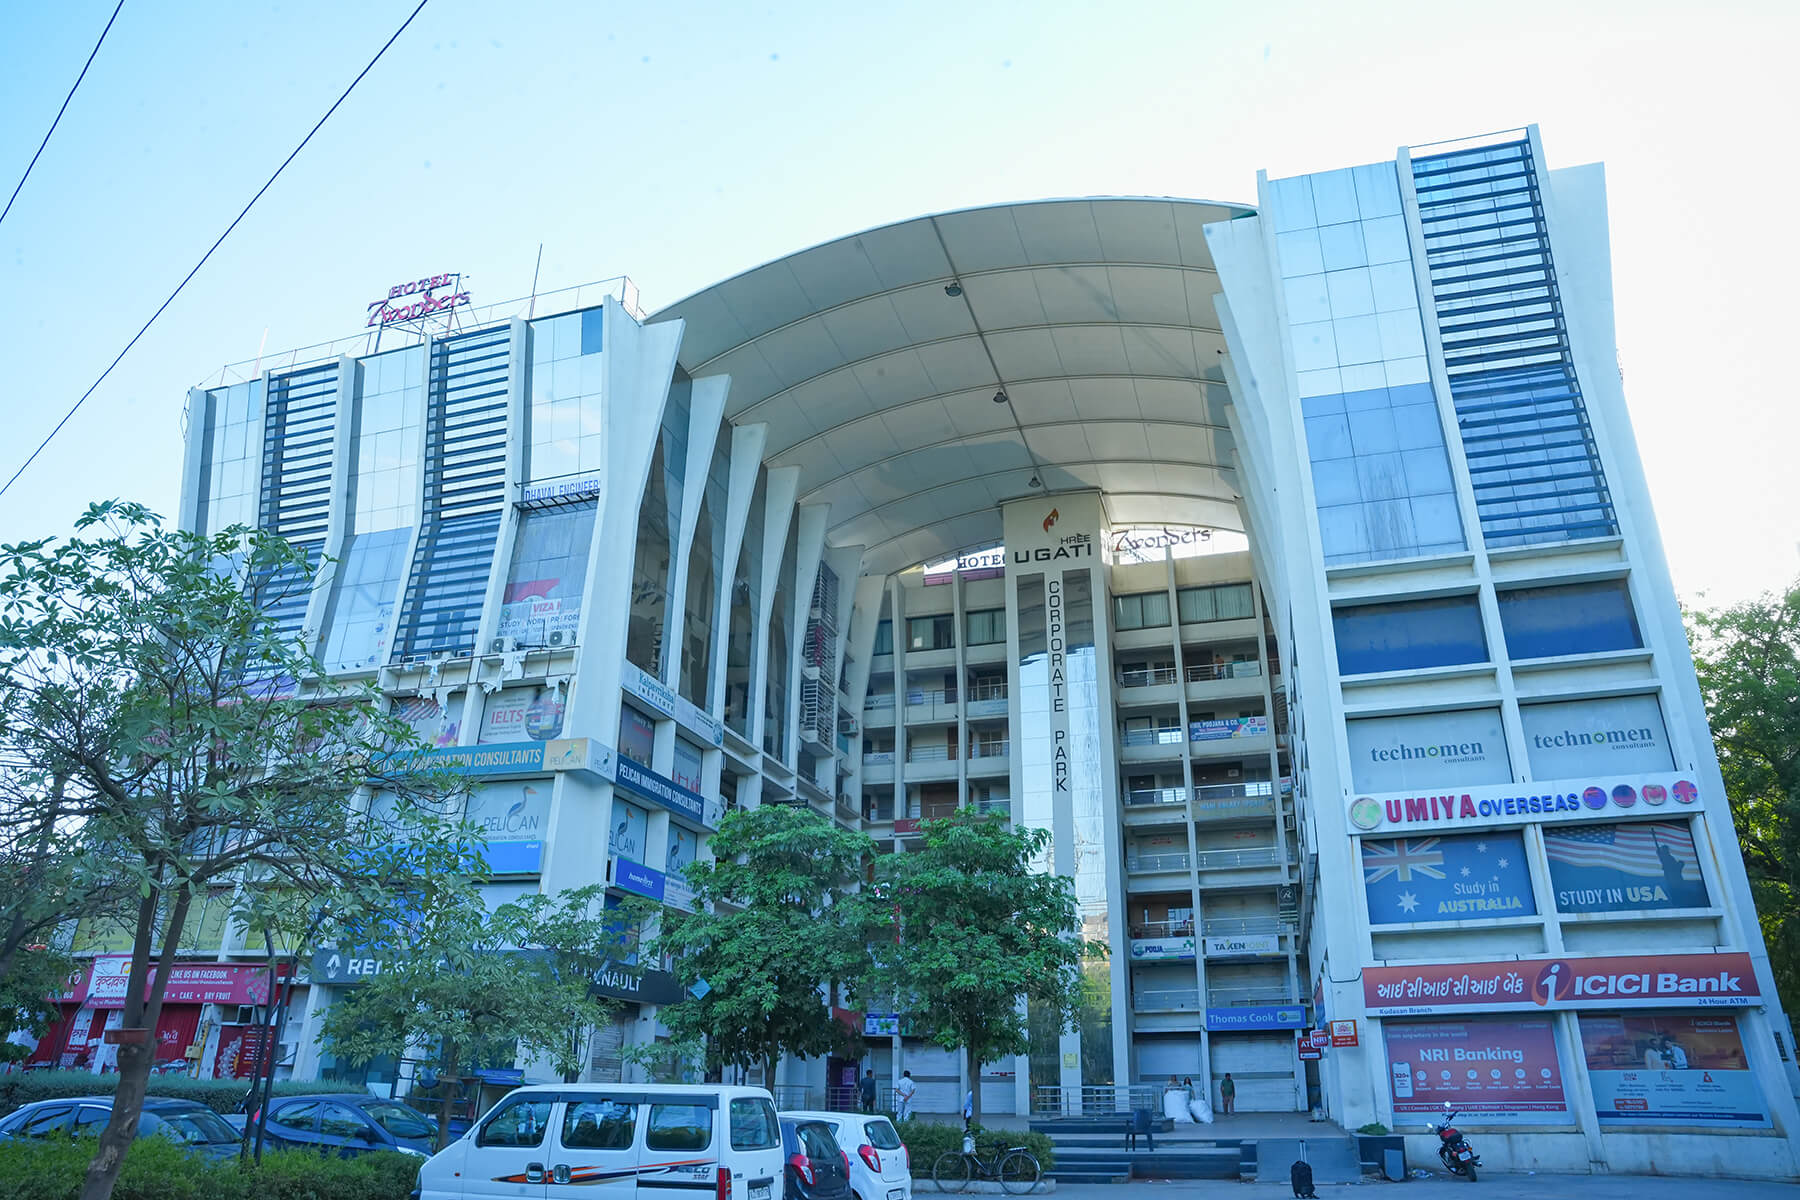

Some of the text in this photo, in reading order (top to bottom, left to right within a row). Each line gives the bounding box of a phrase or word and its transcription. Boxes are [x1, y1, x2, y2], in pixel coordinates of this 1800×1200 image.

[388, 273, 452, 299] HOTEL
[559, 479, 600, 498] ENGINEER
[1014, 545, 1091, 564] UGATI
[1049, 581, 1067, 792] CORPORATE PARK
[491, 709, 524, 724] IELTS
[1534, 728, 1653, 749] technomen
[1612, 741, 1656, 750] consultants
[473, 748, 542, 767] CONSULTANTS
[1370, 742, 1484, 762] technomen
[1444, 756, 1486, 764] consultants
[619, 763, 702, 815] PELICAN IMMIGRATION CONSULTANTS
[1386, 792, 1581, 823] UMIYA OVERSEAS
[1453, 879, 1500, 896] Study in
[1559, 885, 1669, 906] STUDY IN USA
[1437, 895, 1523, 914] AUSTRALIA
[170, 969, 183, 979] LIKE
[200, 968, 228, 978] FACEBOOK
[1503, 972, 1523, 994] બેંક
[1574, 971, 1742, 996] ICICI Bank
[179, 991, 194, 1000] CAKE
[216, 991, 232, 1000] FRUIT
[1209, 1012, 1274, 1024] Thomas Cook
[1419, 1046, 1524, 1063] NRI Banking
